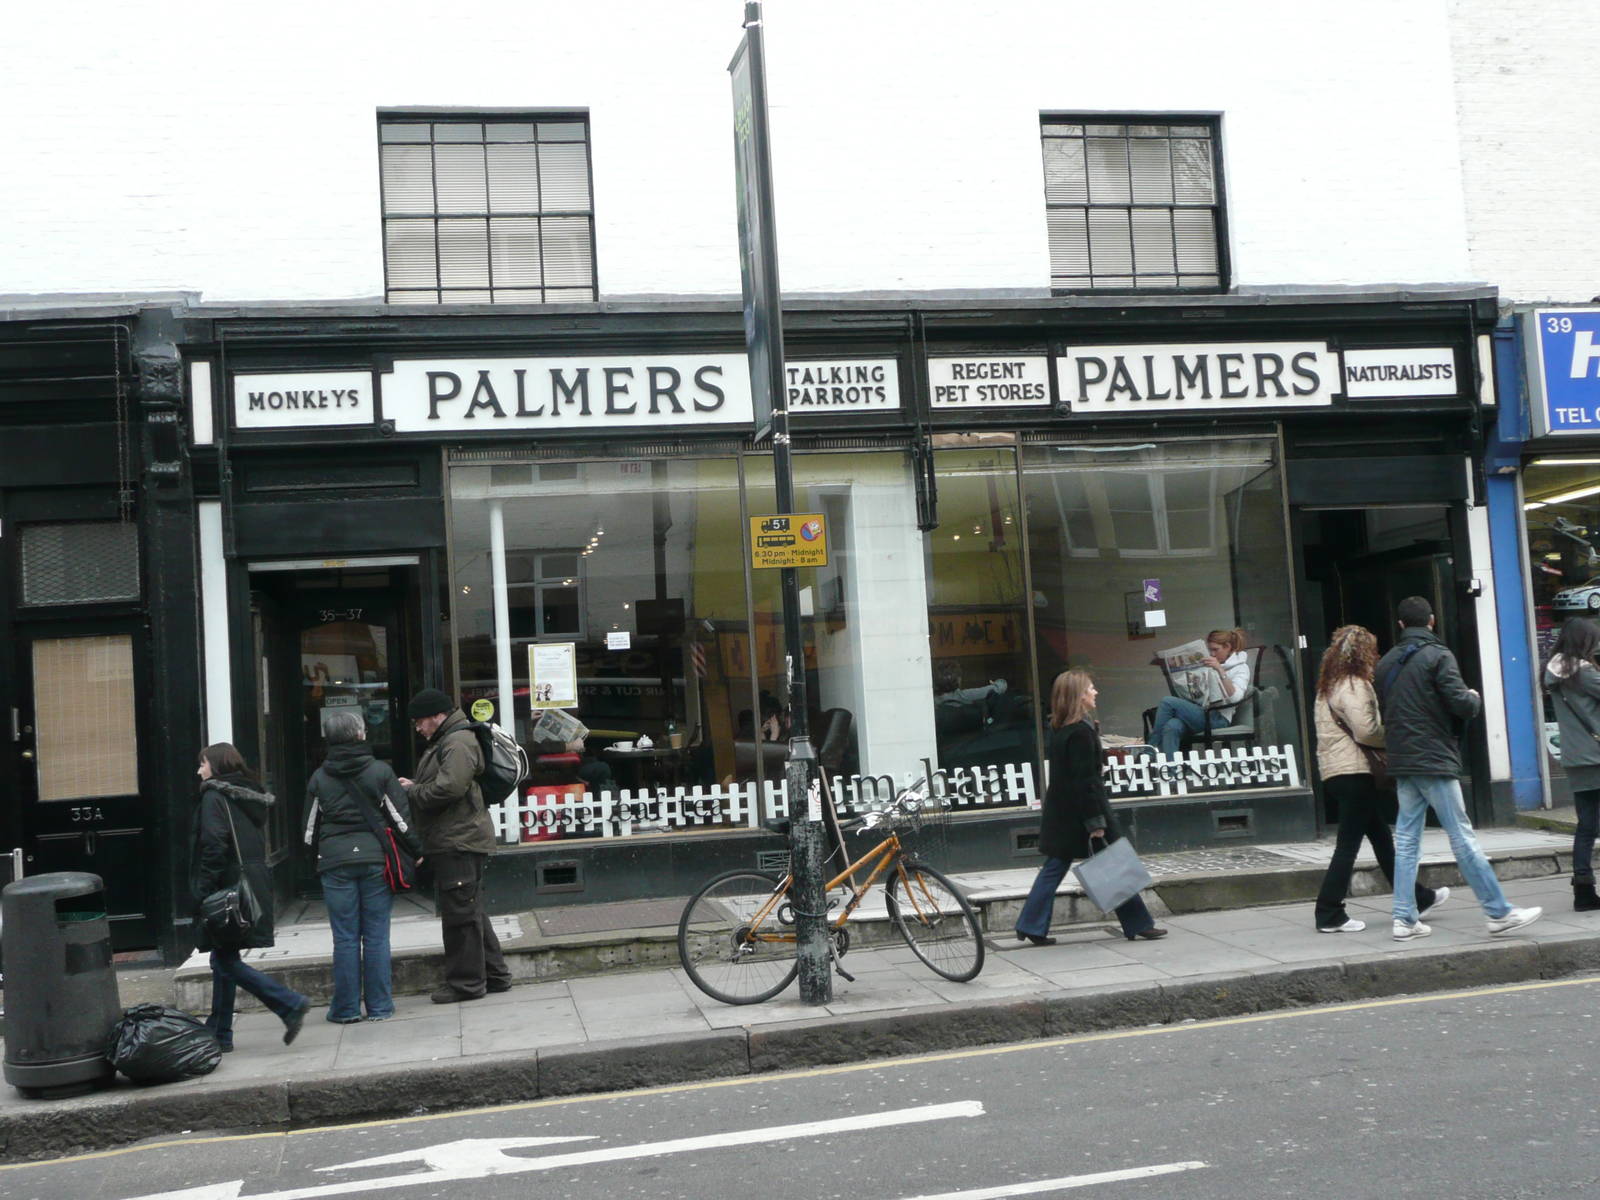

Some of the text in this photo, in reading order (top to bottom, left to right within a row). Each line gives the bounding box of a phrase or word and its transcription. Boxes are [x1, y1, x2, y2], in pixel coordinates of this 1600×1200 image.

[1547, 317, 1573, 334] 39
[787, 365, 886, 385] TALKING
[952, 362, 1026, 380] REGENT
[1075, 351, 1321, 402] PALMERS
[1346, 363, 1453, 383] NATURALISTS
[248, 389, 360, 411] MONKEYS
[426, 365, 726, 420] PALMERS
[788, 386, 887, 406] PARROTS
[935, 383, 1045, 402] PET STORES
[1555, 407, 1592, 423] TEL
[791, 548, 824, 557] Midnight
[71, 807, 104, 821] 33A
[679, 795, 725, 817] tea
